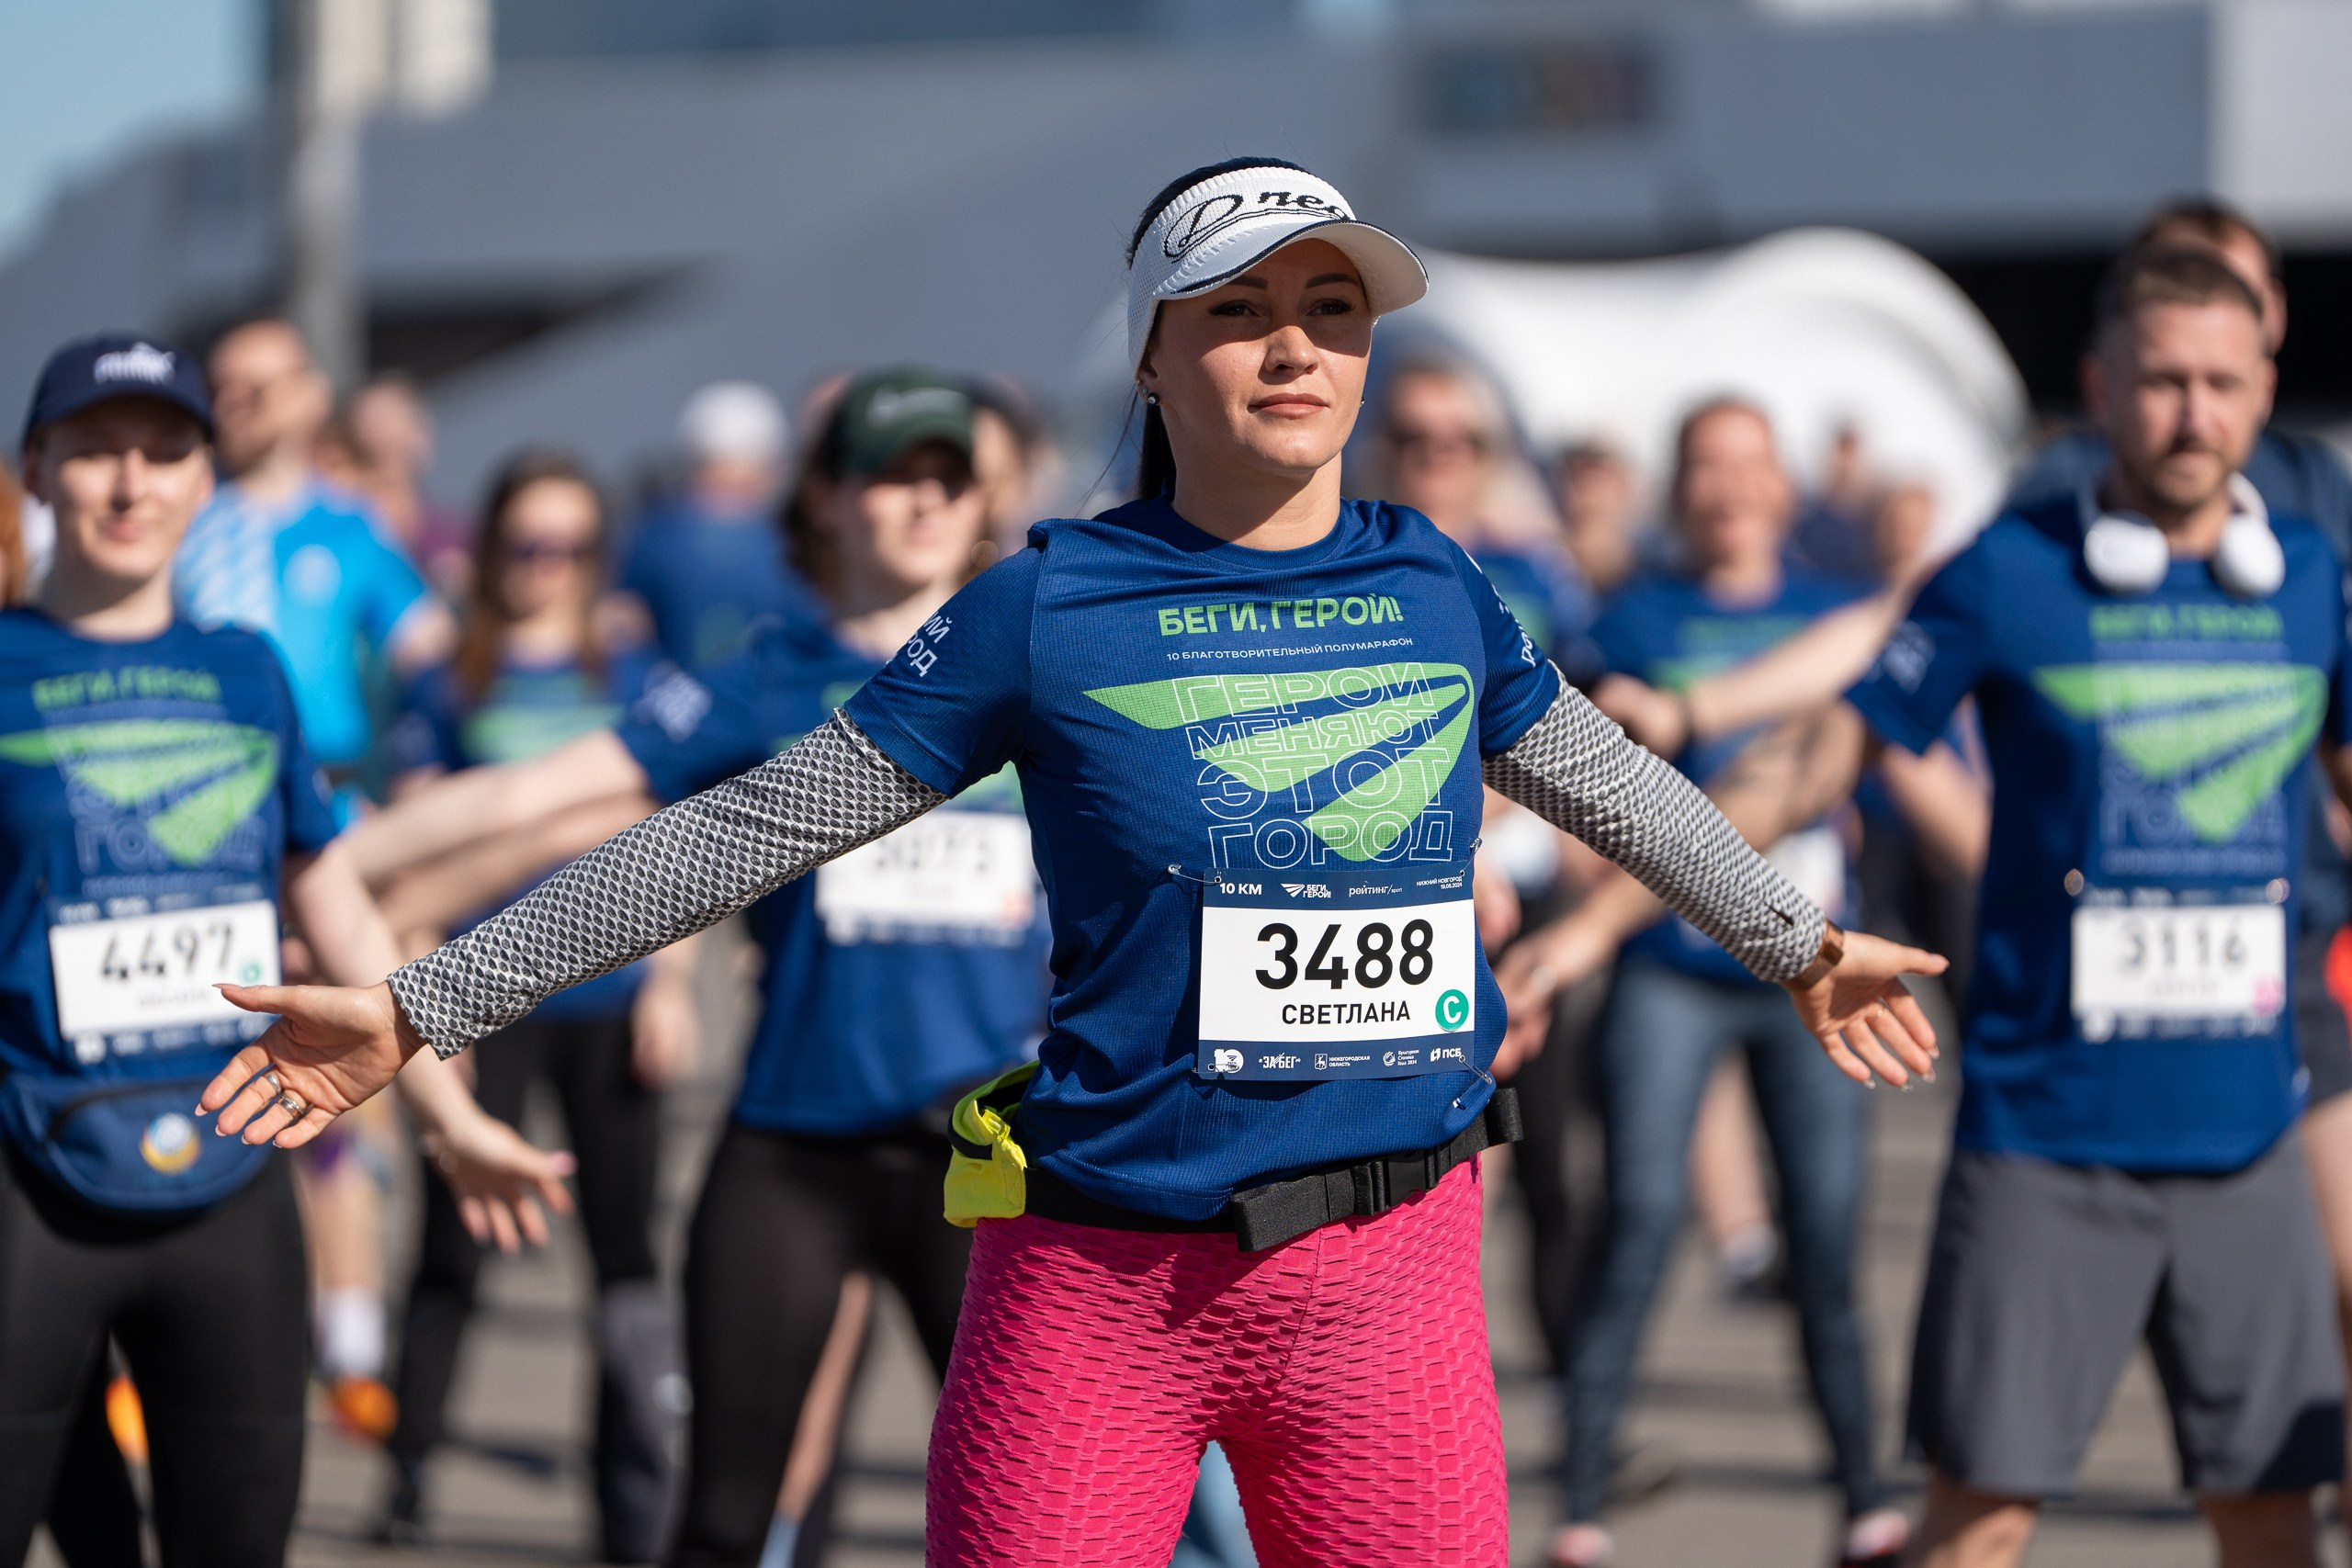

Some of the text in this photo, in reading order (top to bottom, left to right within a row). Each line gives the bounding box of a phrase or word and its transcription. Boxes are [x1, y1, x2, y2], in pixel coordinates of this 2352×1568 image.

[1158, 592, 1405, 637] БЕГИ, ГЕРОЙ!
[1166, 637, 1414, 661] 10 БЛАГОТВОРИТЕЛЬНЫЙ ПОЛУМАРАФОН
[1171, 661, 1435, 724] ГЕРОИ
[1184, 708, 1440, 760] МЕНЯЮТ
[1196, 747, 1450, 820] ЭТОТ
[1207, 810, 1453, 870] ГОРОД
[1219, 882, 1236, 895] 10
[1416, 875, 1463, 886] НИЖНИЙ НОВГОРОД
[101, 922, 233, 981] 4497
[1255, 919, 1434, 990] 3488
[1282, 1000, 1411, 1025] СВЕТЛАНА
[1442, 1047, 1463, 1059] ПСБ
